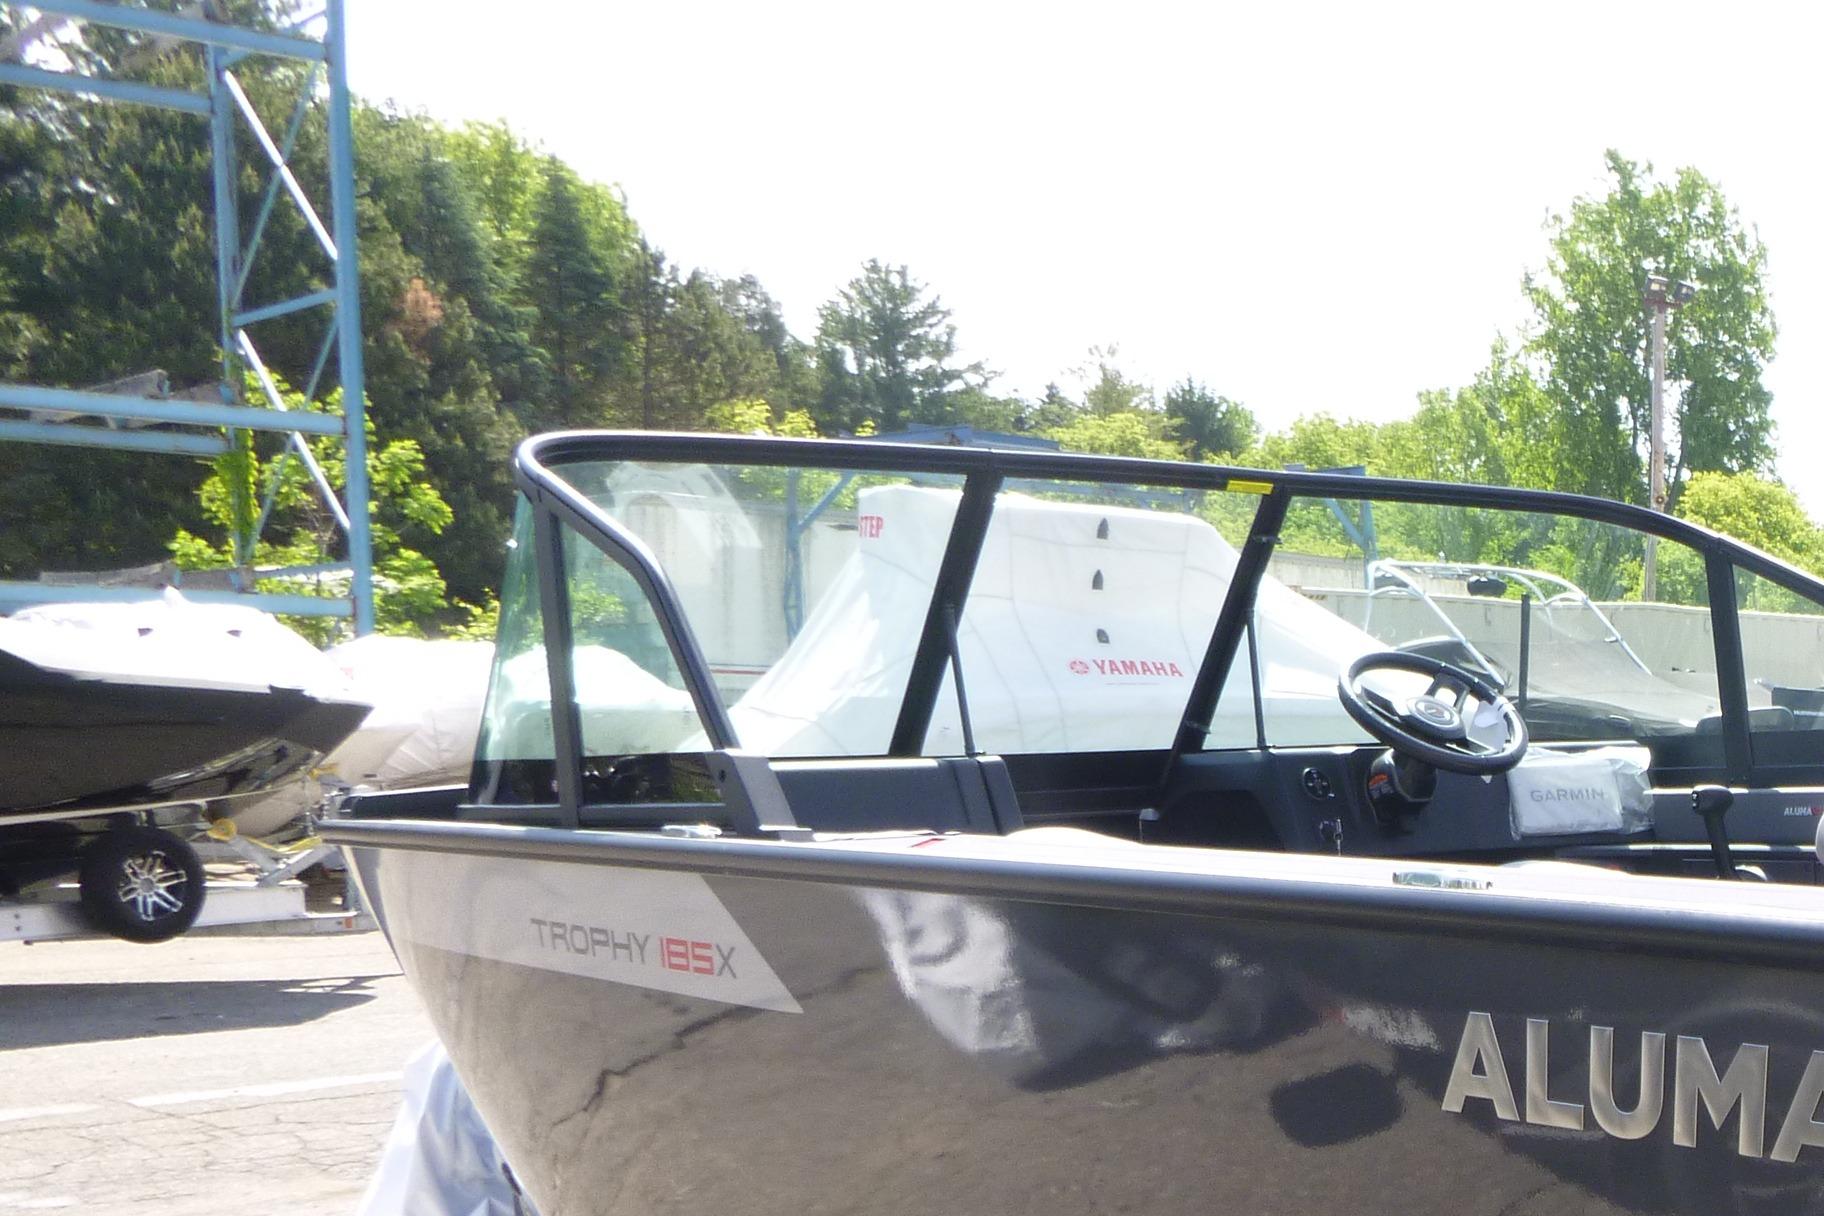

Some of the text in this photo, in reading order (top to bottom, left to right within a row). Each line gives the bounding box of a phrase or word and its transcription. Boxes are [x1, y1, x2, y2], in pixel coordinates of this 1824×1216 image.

[1092, 659, 1184, 678] YAMAHA
[1529, 788, 1605, 802] GARMIN
[530, 916, 738, 980] TROPHY 185X
